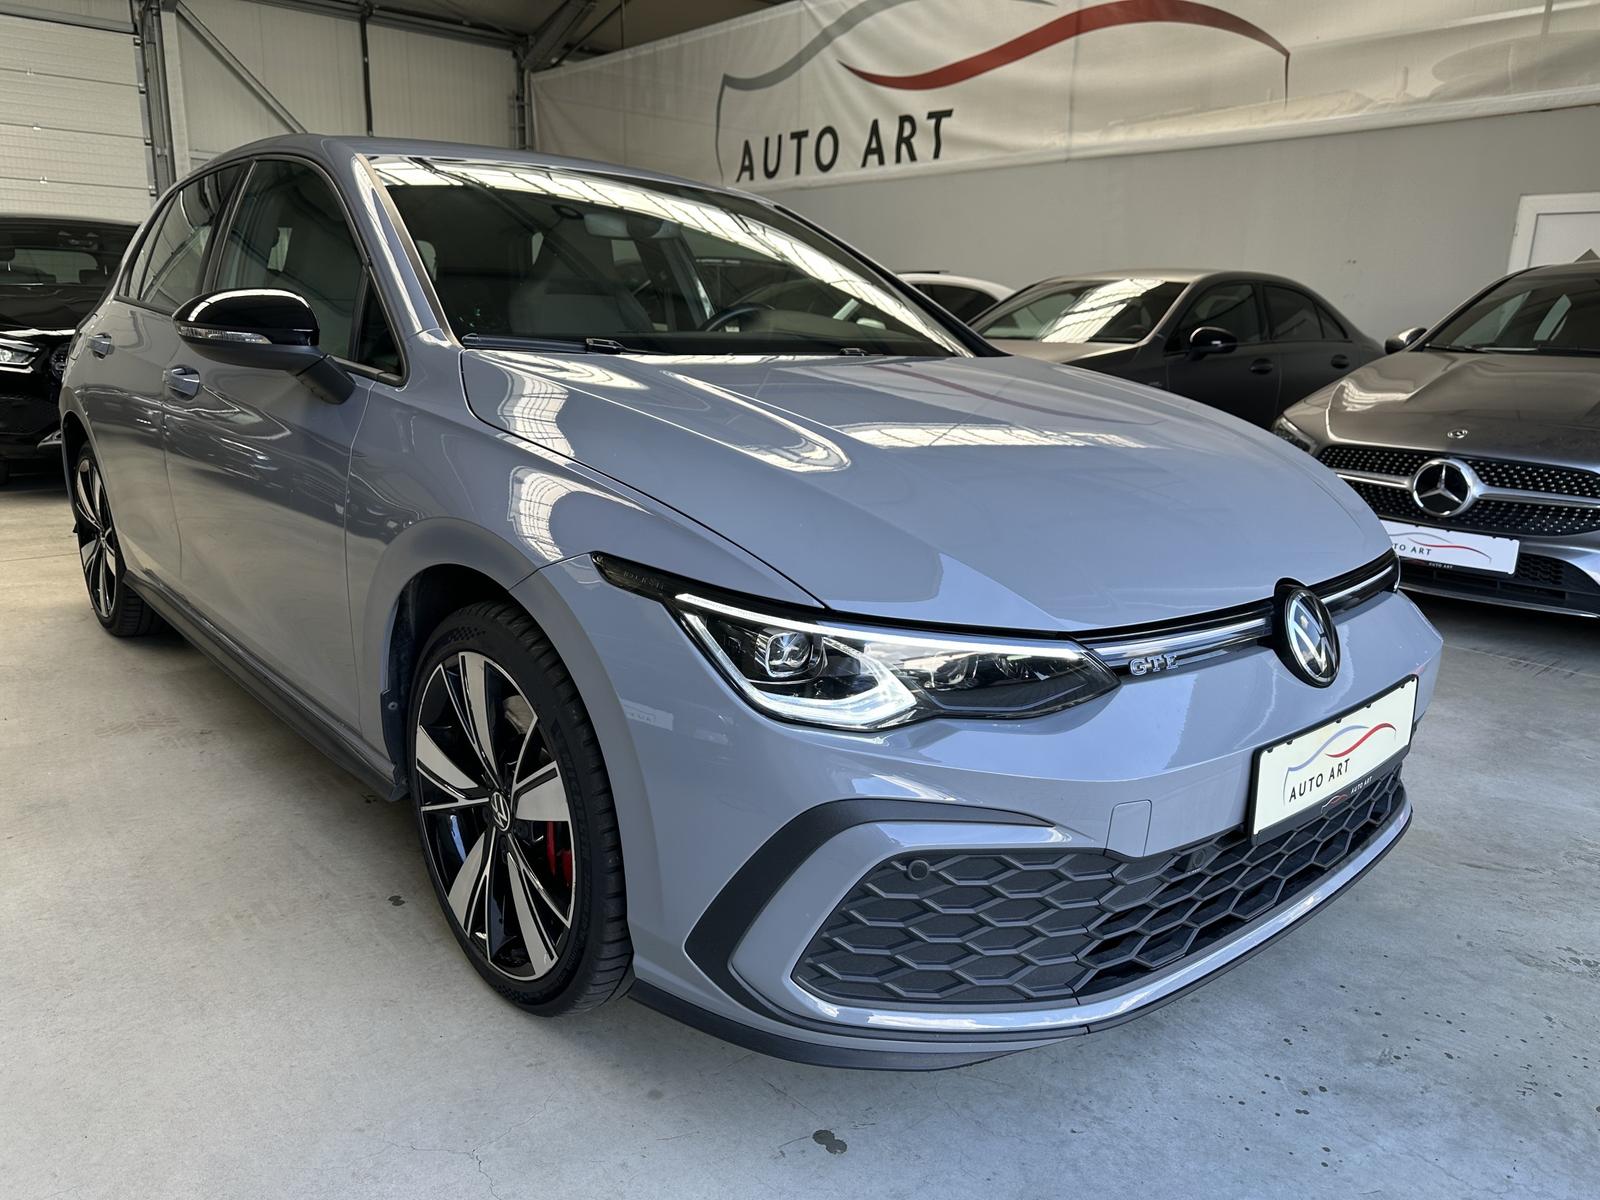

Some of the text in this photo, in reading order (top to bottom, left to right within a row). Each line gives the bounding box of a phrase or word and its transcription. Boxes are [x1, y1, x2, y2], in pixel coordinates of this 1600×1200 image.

[736, 108, 954, 183] AUTO ART
[1393, 543, 1432, 556] TO ART
[1129, 653, 1179, 676] GTE
[1289, 758, 1350, 803] AUTO ART
[1350, 776, 1373, 795] AUTO ART
